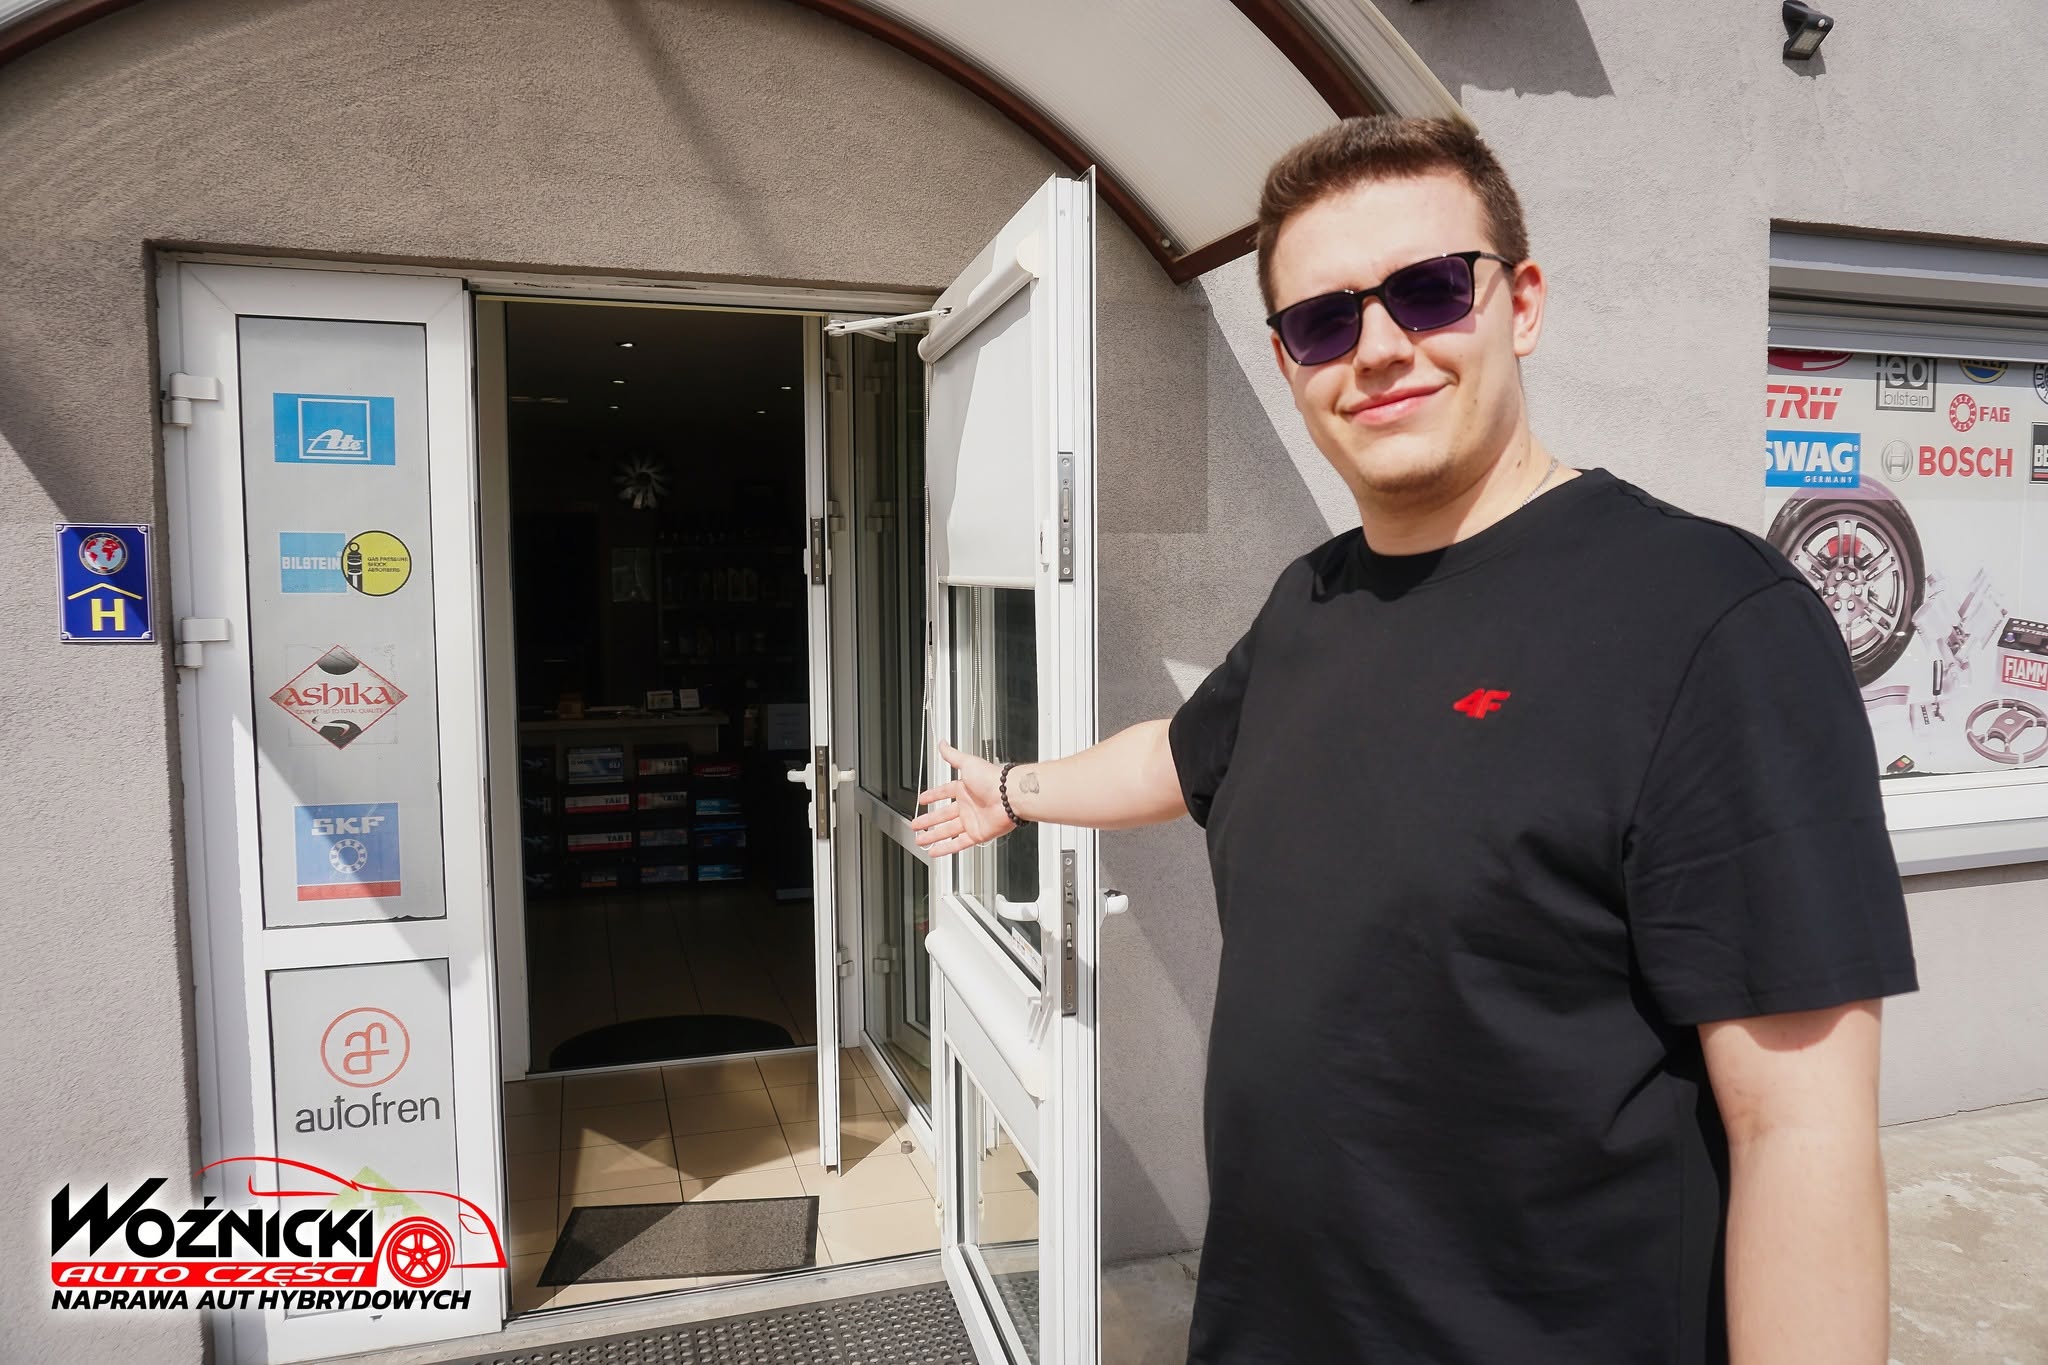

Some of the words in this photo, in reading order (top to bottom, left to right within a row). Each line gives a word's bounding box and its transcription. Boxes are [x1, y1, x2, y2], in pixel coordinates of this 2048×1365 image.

[1766, 384, 1843, 419] TRW
[1884, 391, 1929, 406] bilstein
[1979, 406, 2010, 422] FAG
[1918, 445, 2013, 478] BOSCH
[1804, 475, 1853, 483] GERMANY
[281, 556, 341, 570] BILSTEIN
[91, 598, 126, 632] H
[2005, 657, 2048, 684] FIAMM
[1453, 688, 1512, 720] 4F
[312, 816, 385, 835] SKF
[295, 1092, 440, 1133] autofren
